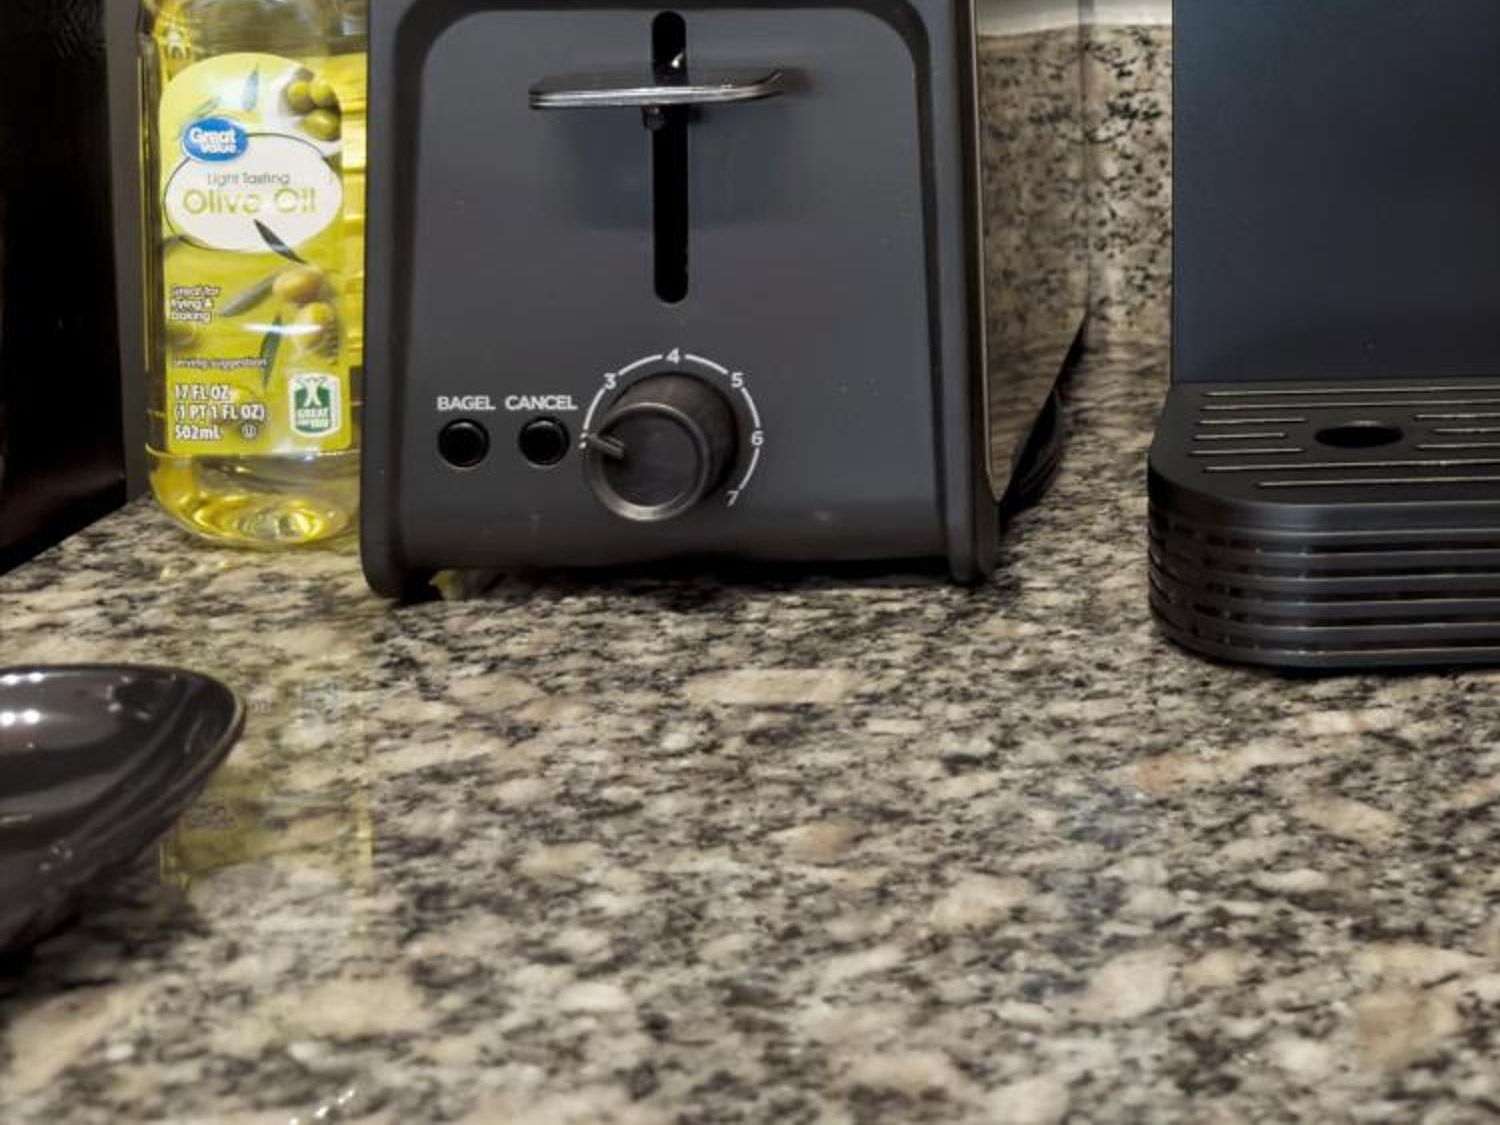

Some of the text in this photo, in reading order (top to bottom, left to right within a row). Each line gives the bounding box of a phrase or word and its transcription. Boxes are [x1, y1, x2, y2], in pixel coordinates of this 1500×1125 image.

[183, 187, 317, 215] Olive Oil
[665, 348, 680, 364] 4
[604, 373, 617, 390] 3
[730, 372, 744, 388] 5
[192, 383, 209, 400] FL
[436, 395, 497, 411] BAGEL
[504, 394, 579, 411] CANCEL
[222, 403, 239, 420] FL
[750, 430, 764, 446] 6
[726, 489, 740, 507] 7
